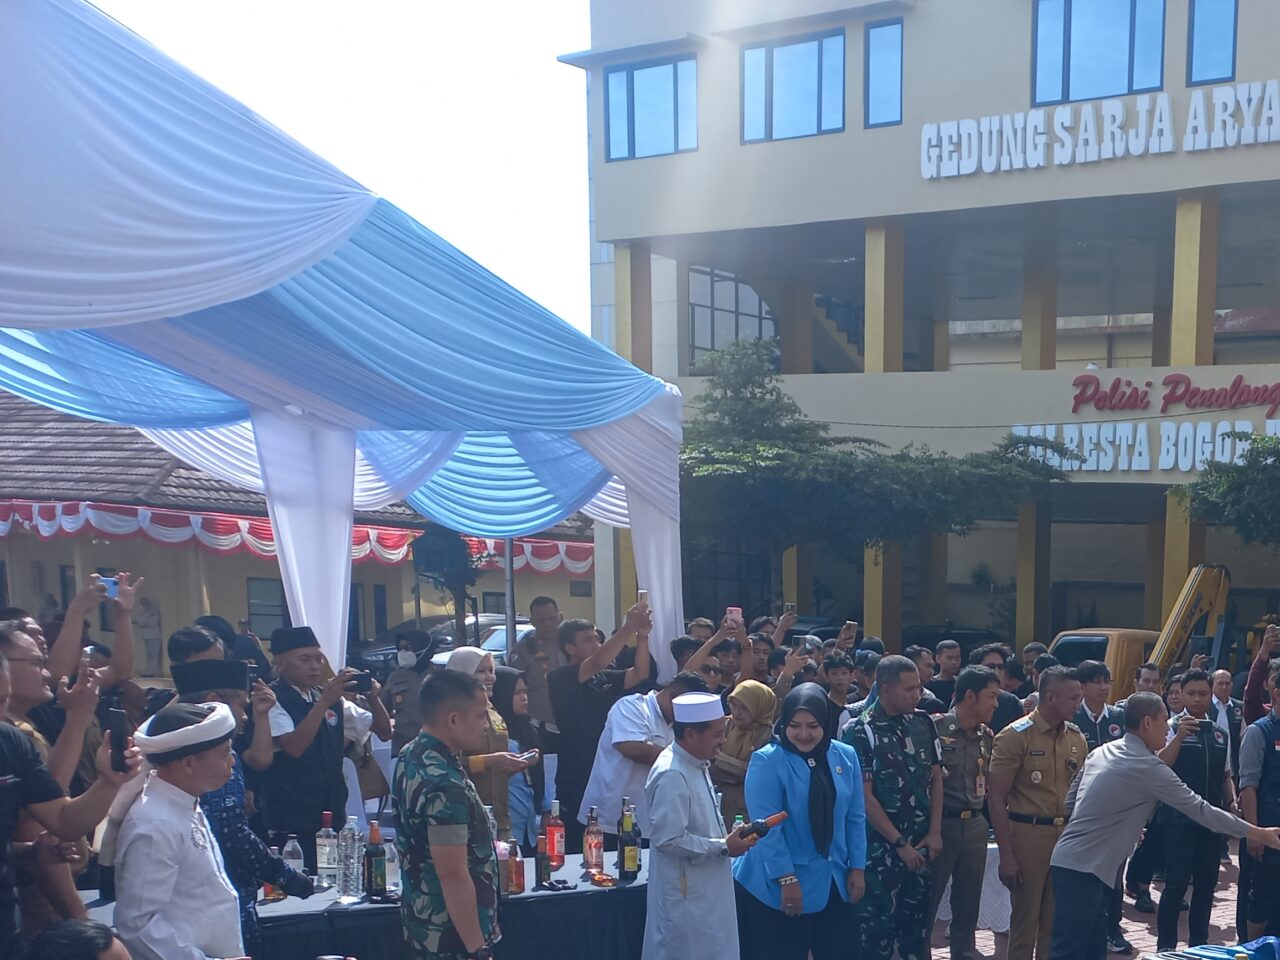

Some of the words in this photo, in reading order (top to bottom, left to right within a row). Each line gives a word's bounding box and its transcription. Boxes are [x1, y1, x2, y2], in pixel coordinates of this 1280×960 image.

[920, 109, 1049, 181] GEDUNG
[1053, 92, 1175, 166] SARJA
[1071, 373, 1154, 414] Polisi
